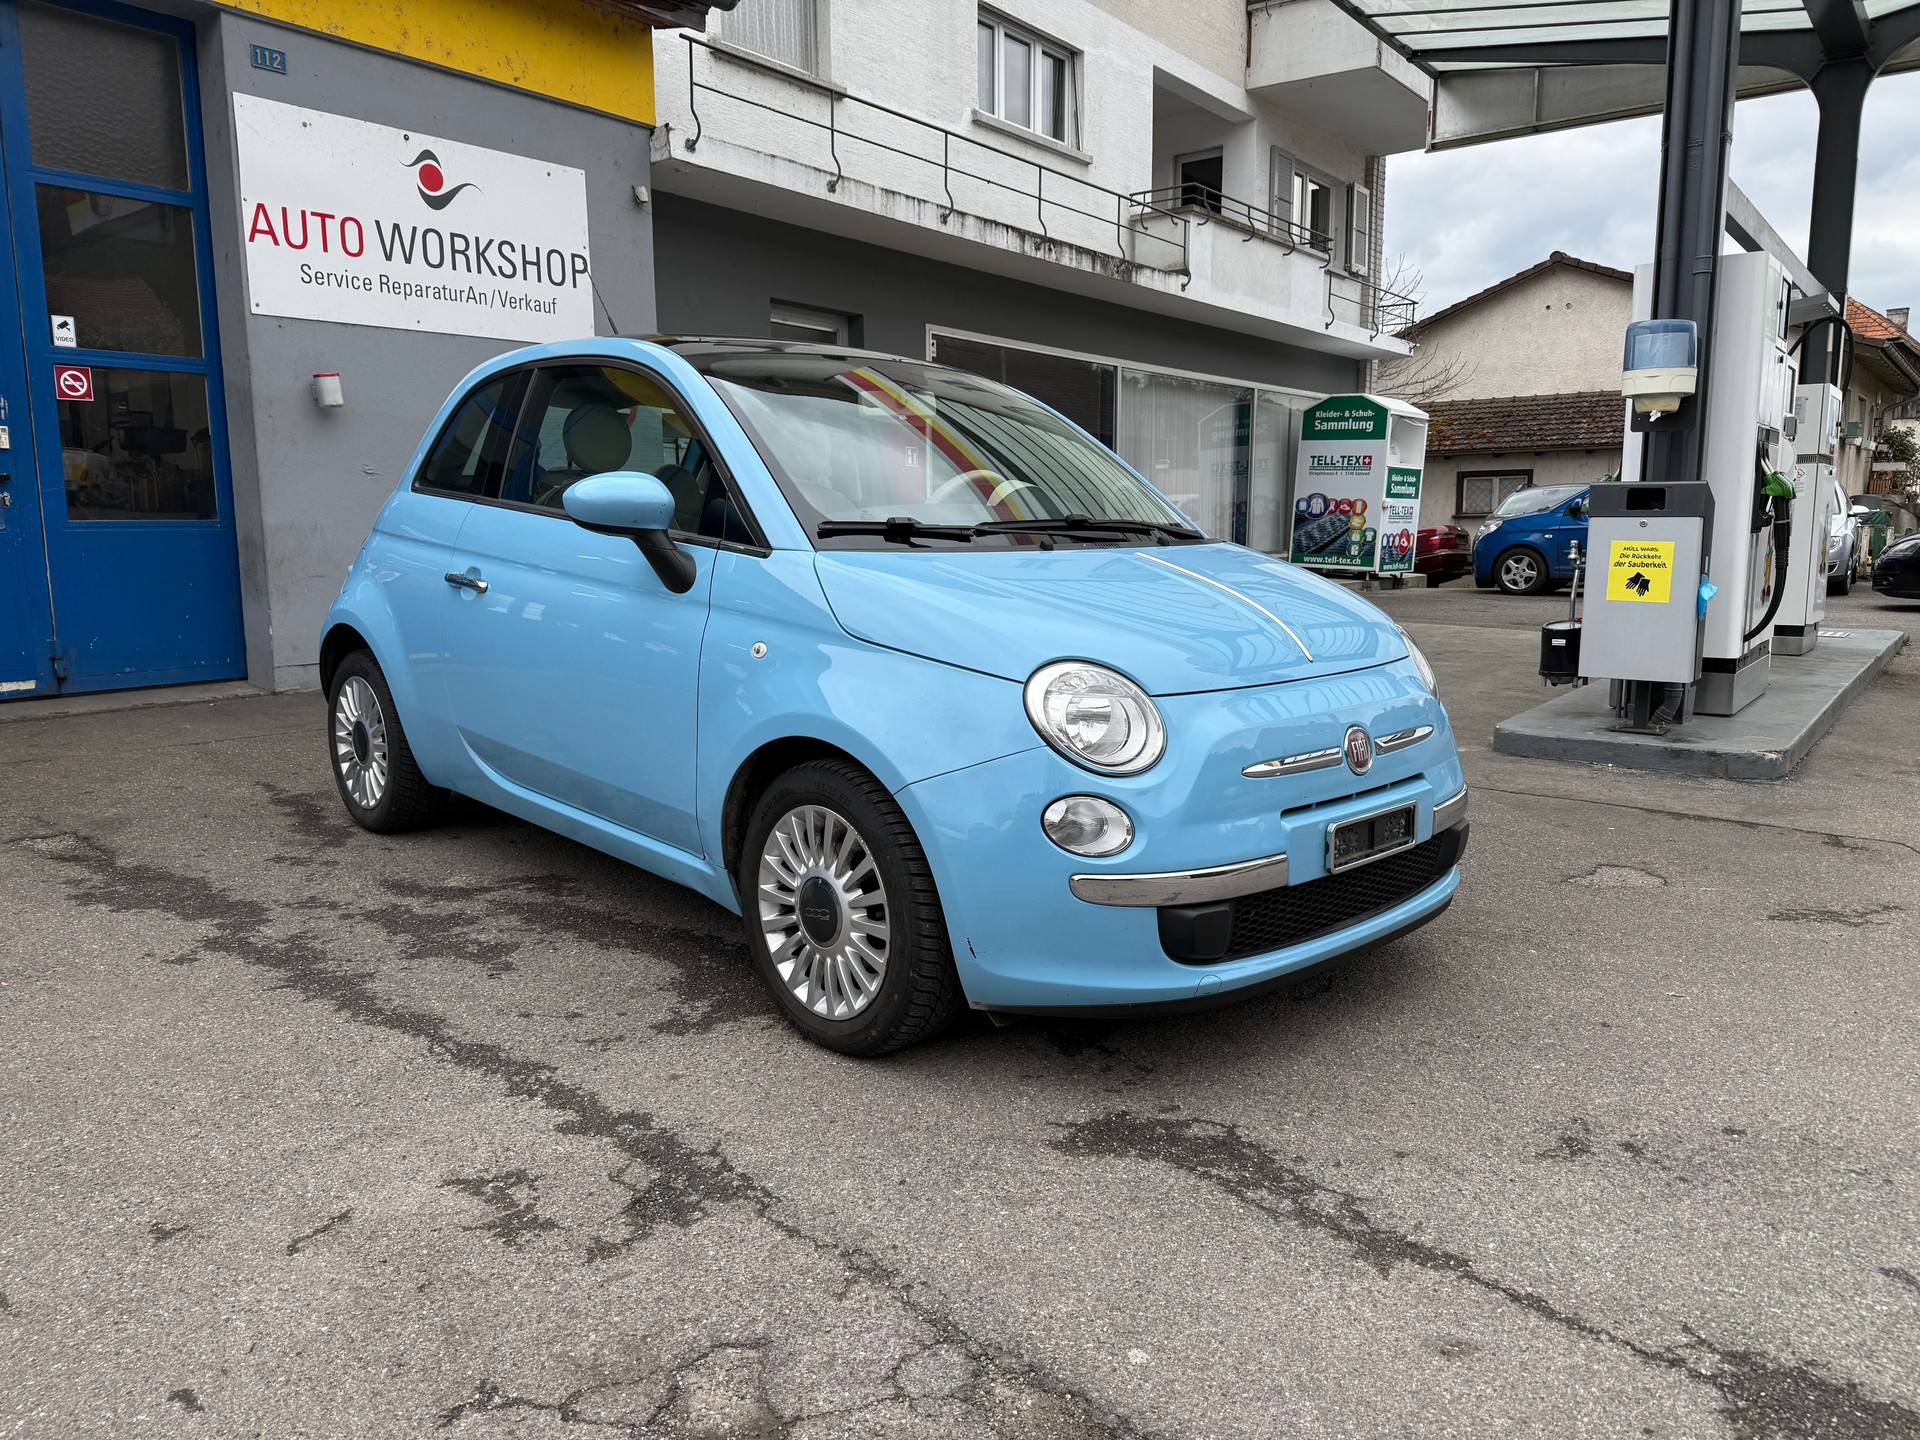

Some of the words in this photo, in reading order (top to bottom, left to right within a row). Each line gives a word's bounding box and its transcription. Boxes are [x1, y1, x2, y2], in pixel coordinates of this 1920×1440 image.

[256, 48, 282, 69] 112
[248, 202, 365, 258] AUTO
[374, 219, 588, 289] WORKSHOP
[300, 263, 373, 292] Service
[55, 335, 75, 343] VIDEO
[1315, 410, 1343, 418] Kleider-
[1344, 410, 1350, 418] &
[1351, 409, 1376, 418] Schuh-
[1314, 418, 1374, 432] Sammlung
[1310, 455, 1362, 466] TELL-TEX
[1390, 483, 1416, 497] Sammlung
[1303, 556, 1361, 565] www.tell-tex.ch
[1351, 739, 1369, 763] FIAT
